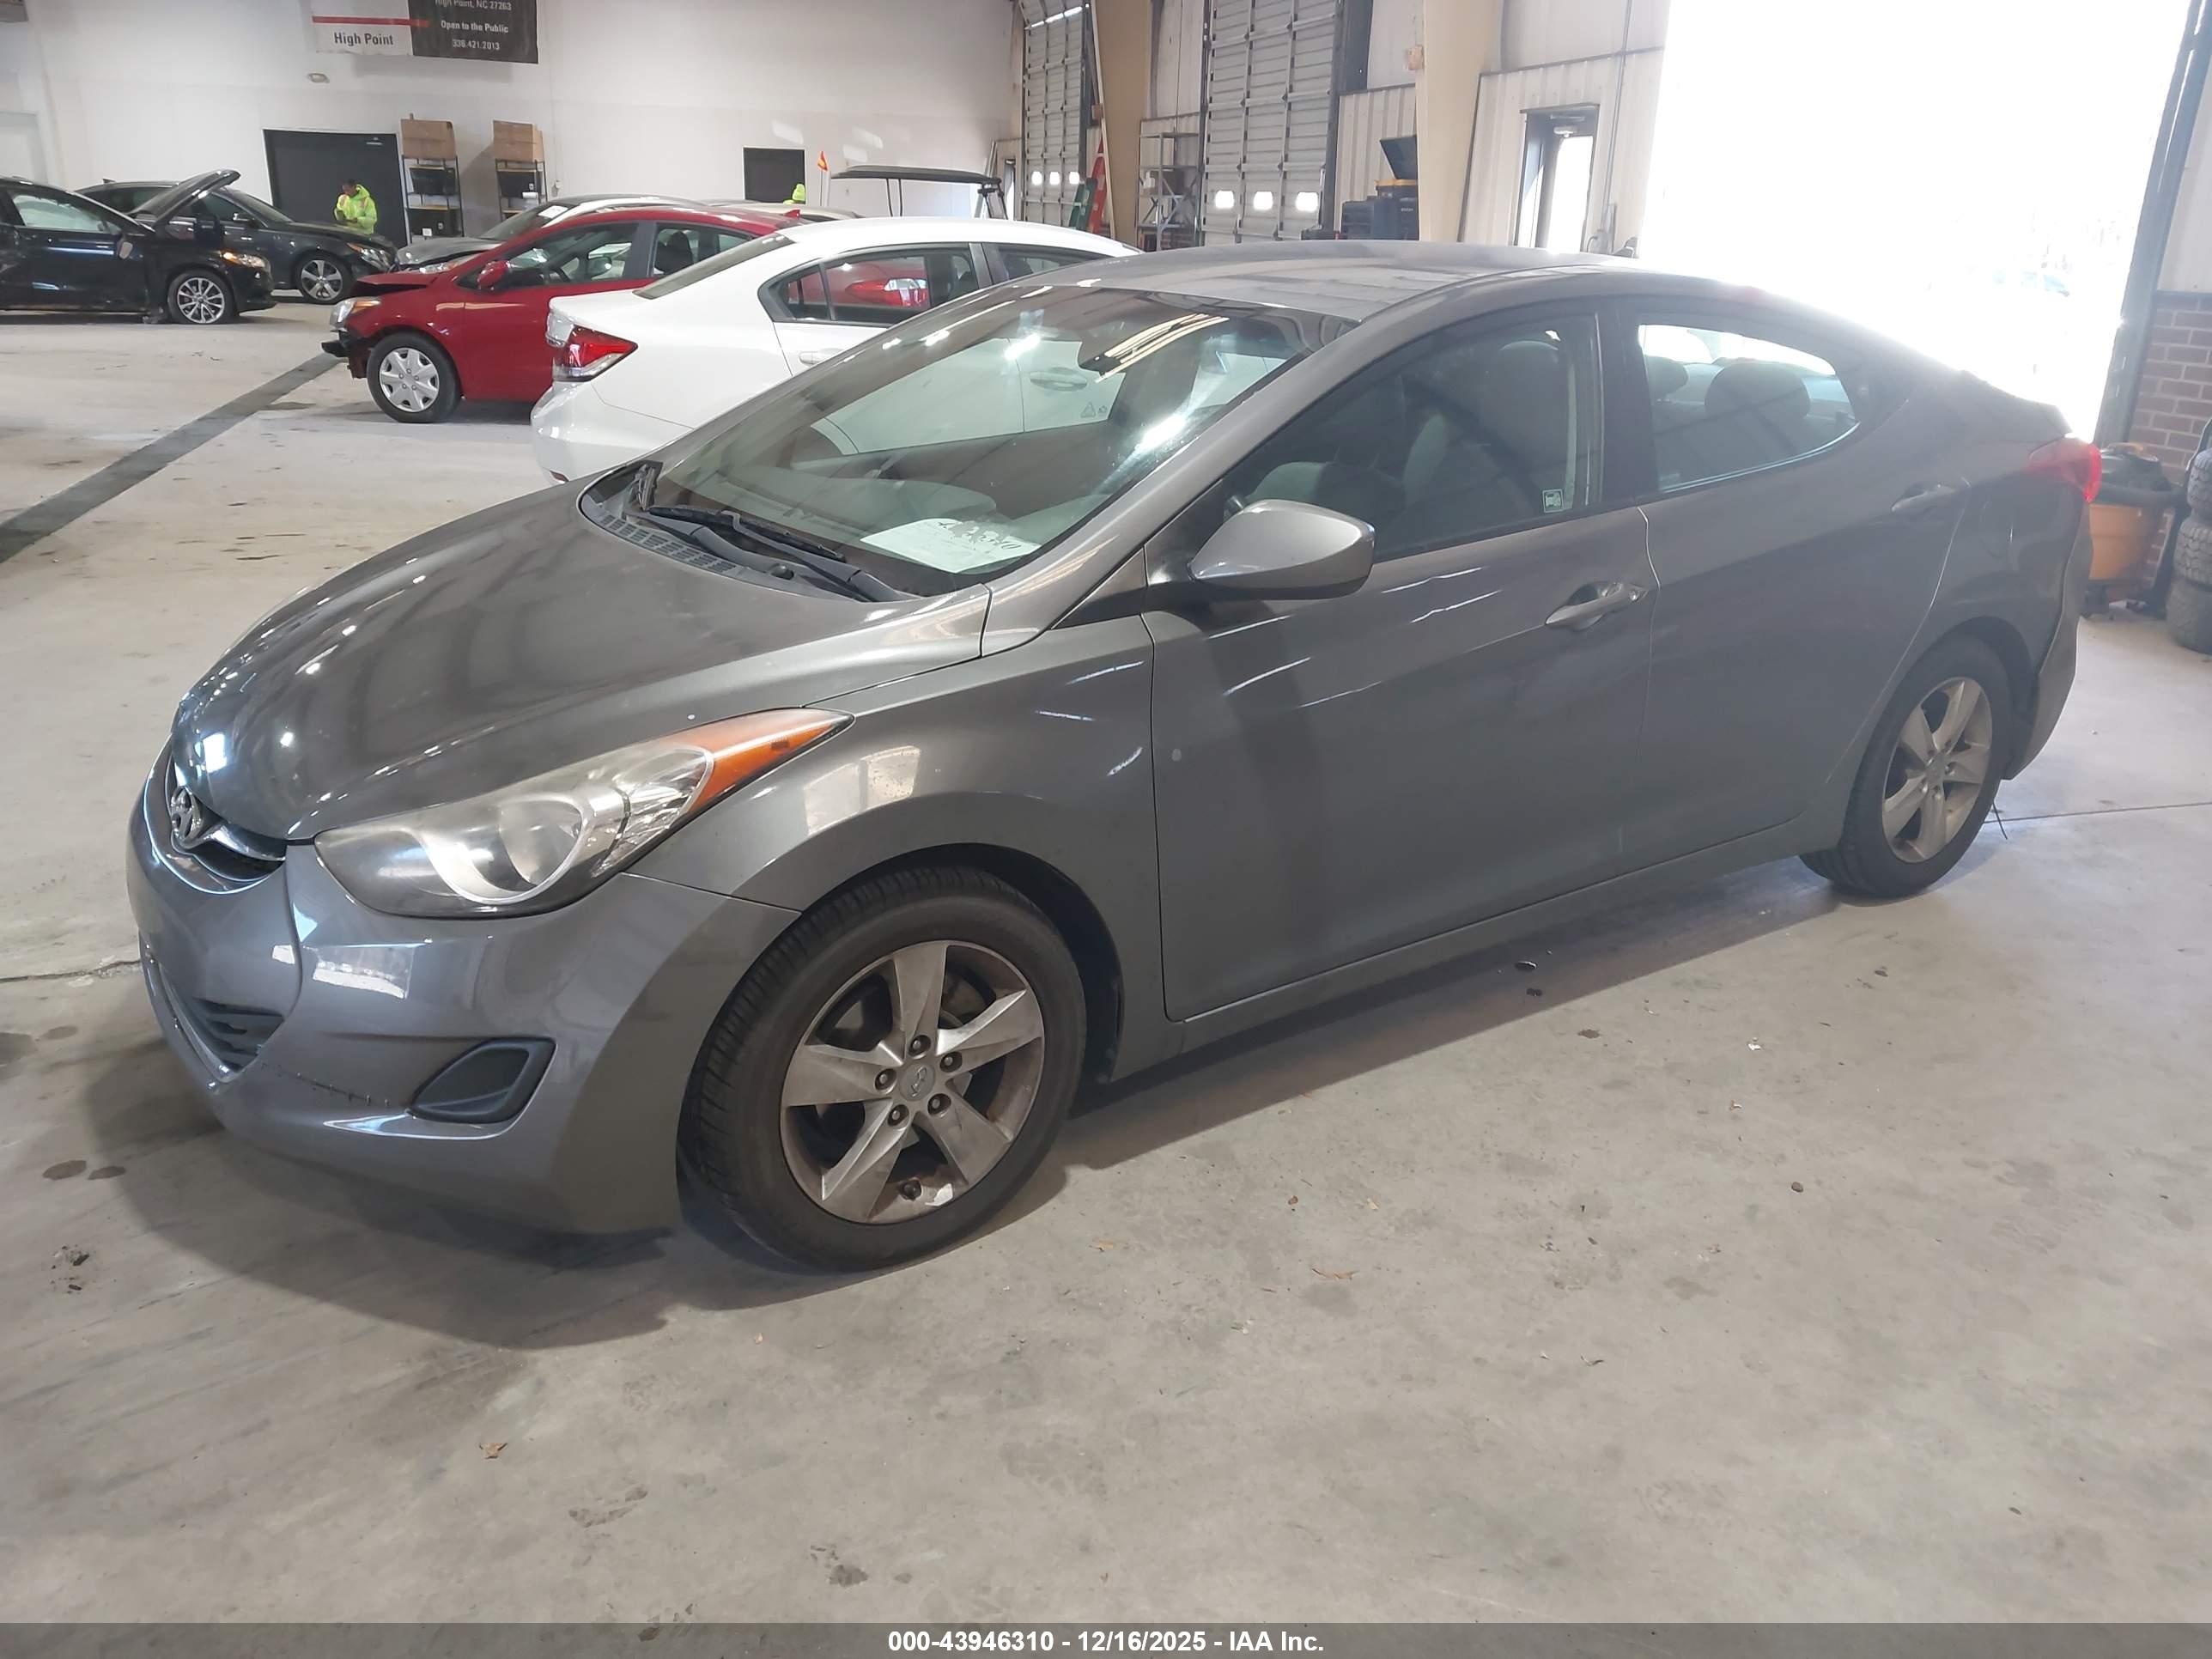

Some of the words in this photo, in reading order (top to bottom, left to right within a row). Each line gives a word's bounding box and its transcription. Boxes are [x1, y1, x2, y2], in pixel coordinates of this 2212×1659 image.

[476, 0, 488, 9] NC
[441, 20, 460, 31] Open
[471, 22, 483, 31] the
[484, 23, 508, 33] Public
[334, 32, 361, 46] High
[364, 33, 393, 45] Point
